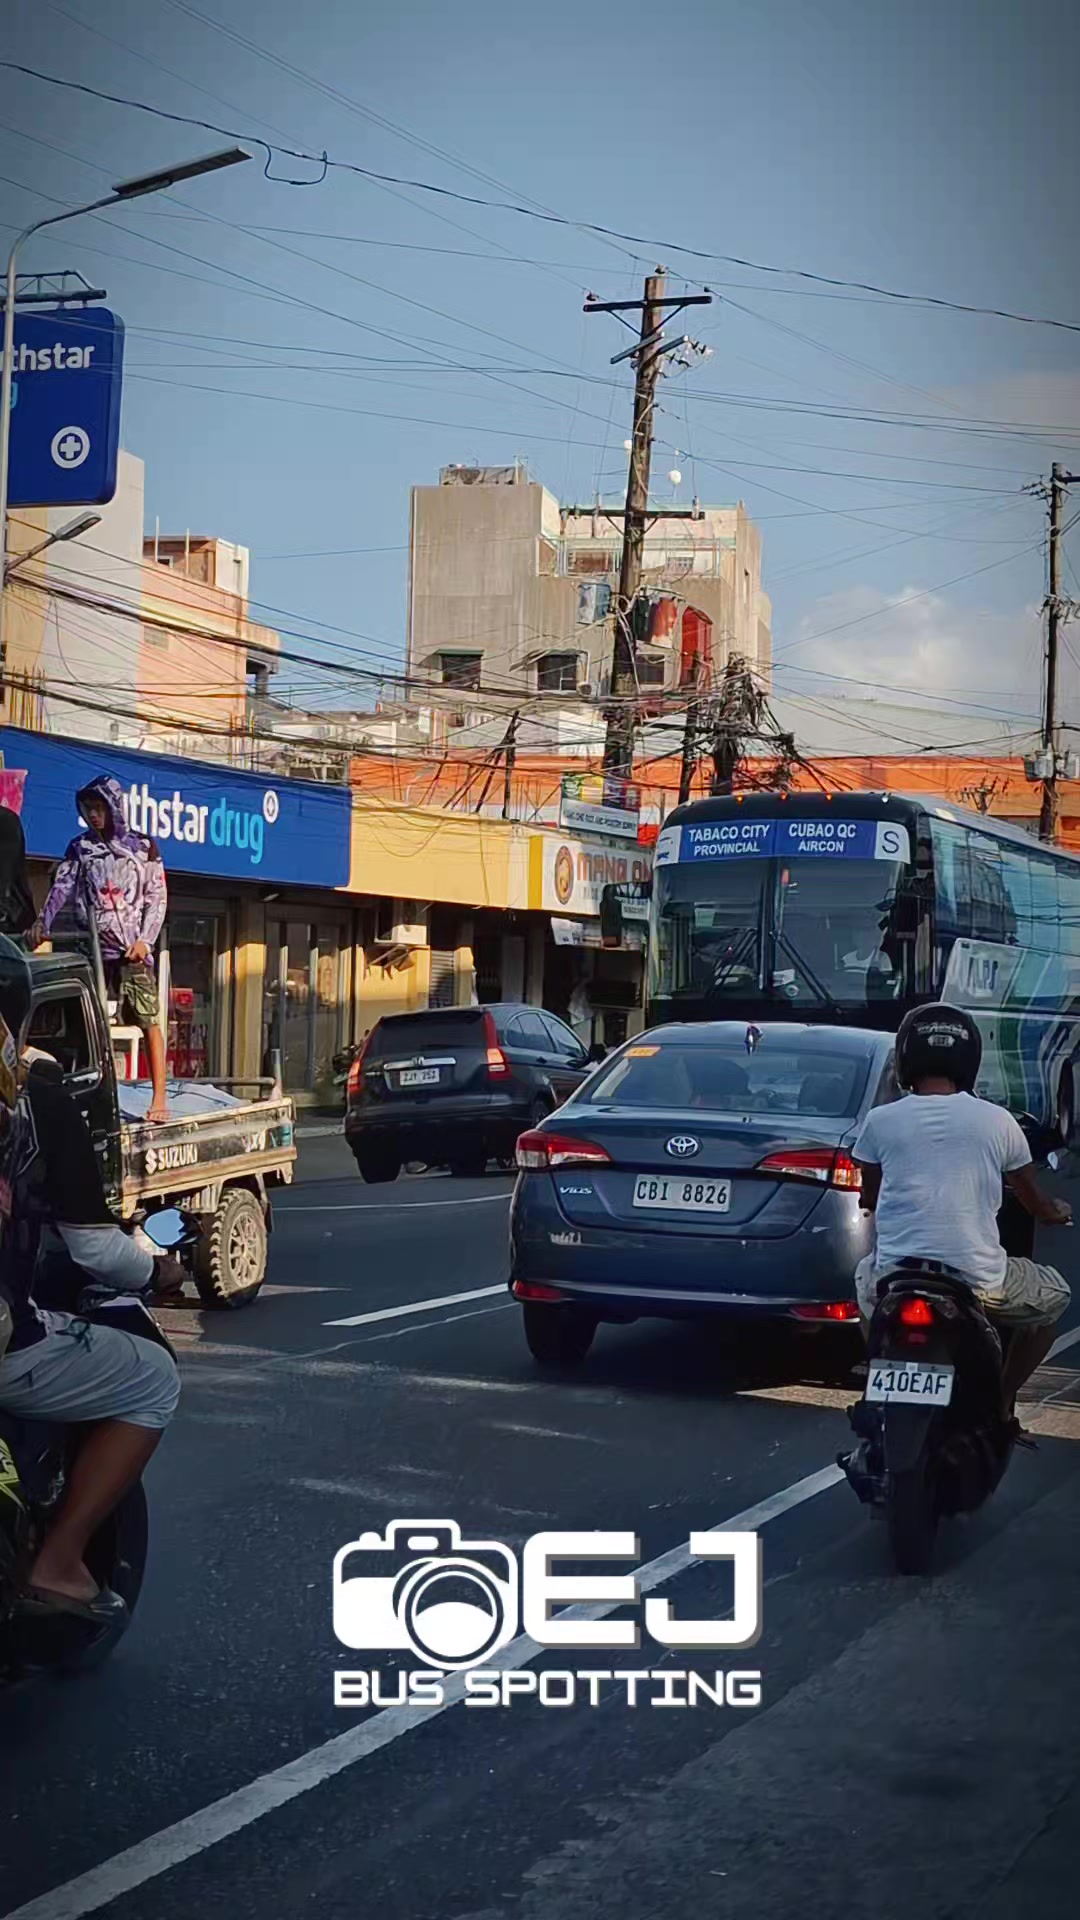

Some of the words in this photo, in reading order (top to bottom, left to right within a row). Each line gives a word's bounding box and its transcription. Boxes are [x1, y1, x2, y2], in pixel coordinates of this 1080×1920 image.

[0, 342, 95, 371] thstar
[78, 784, 208, 843] thstar
[210, 798, 264, 864] drug
[688, 825, 739, 842] TABACO
[741, 824, 770, 839] CITY
[788, 823, 833, 838] CUBAO
[837, 823, 856, 838] QC
[693, 841, 760, 856] PROVINCIAL
[798, 840, 844, 852] AIRCON
[882, 830, 900, 853] S
[158, 1143, 198, 1171] SUZUKI
[637, 1181, 669, 1201] CBI
[682, 1184, 727, 1205] 8826
[871, 1370, 948, 1395] 410EAF
